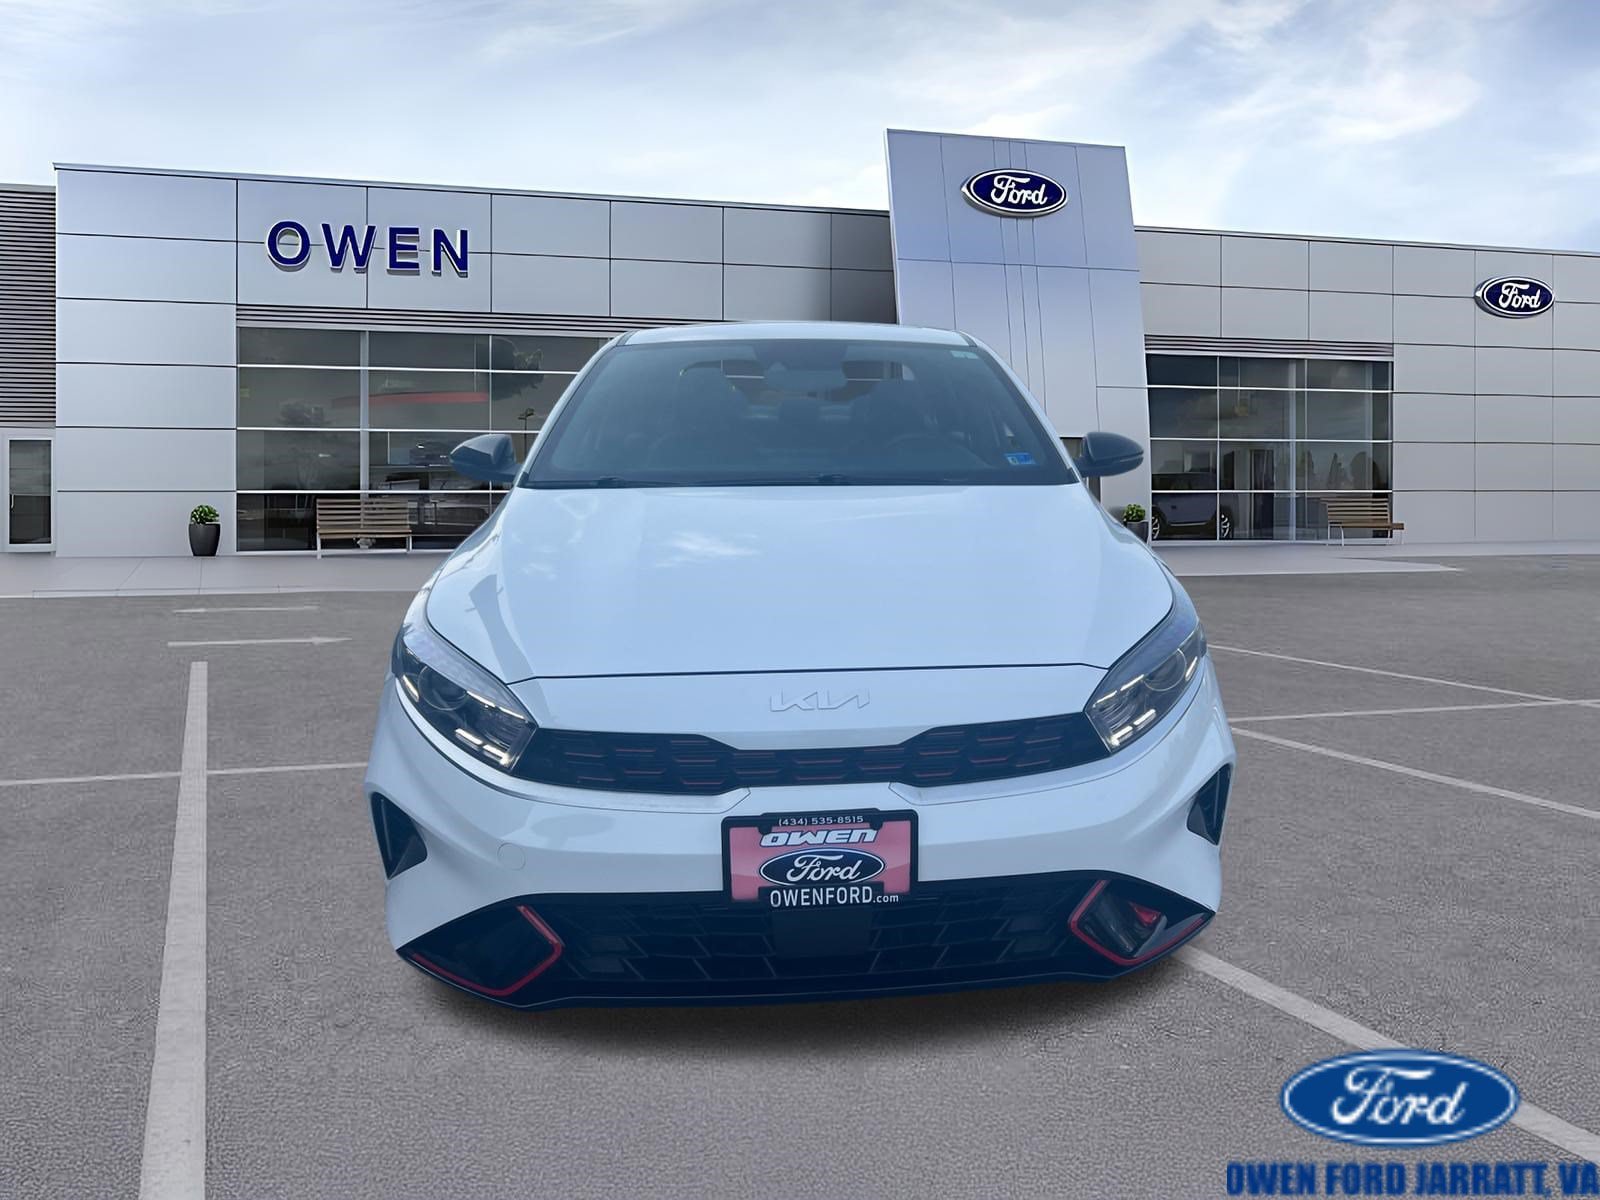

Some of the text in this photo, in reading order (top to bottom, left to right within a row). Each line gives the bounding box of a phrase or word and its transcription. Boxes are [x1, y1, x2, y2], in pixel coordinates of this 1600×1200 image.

[991, 175, 1048, 204] Ford
[265, 219, 469, 277] OWEN
[1499, 282, 1541, 308] Ford
[778, 818, 808, 826] (434)
[760, 829, 878, 847] OWEN
[786, 854, 862, 881] Ford
[769, 886, 899, 908] OWENFORD.com
